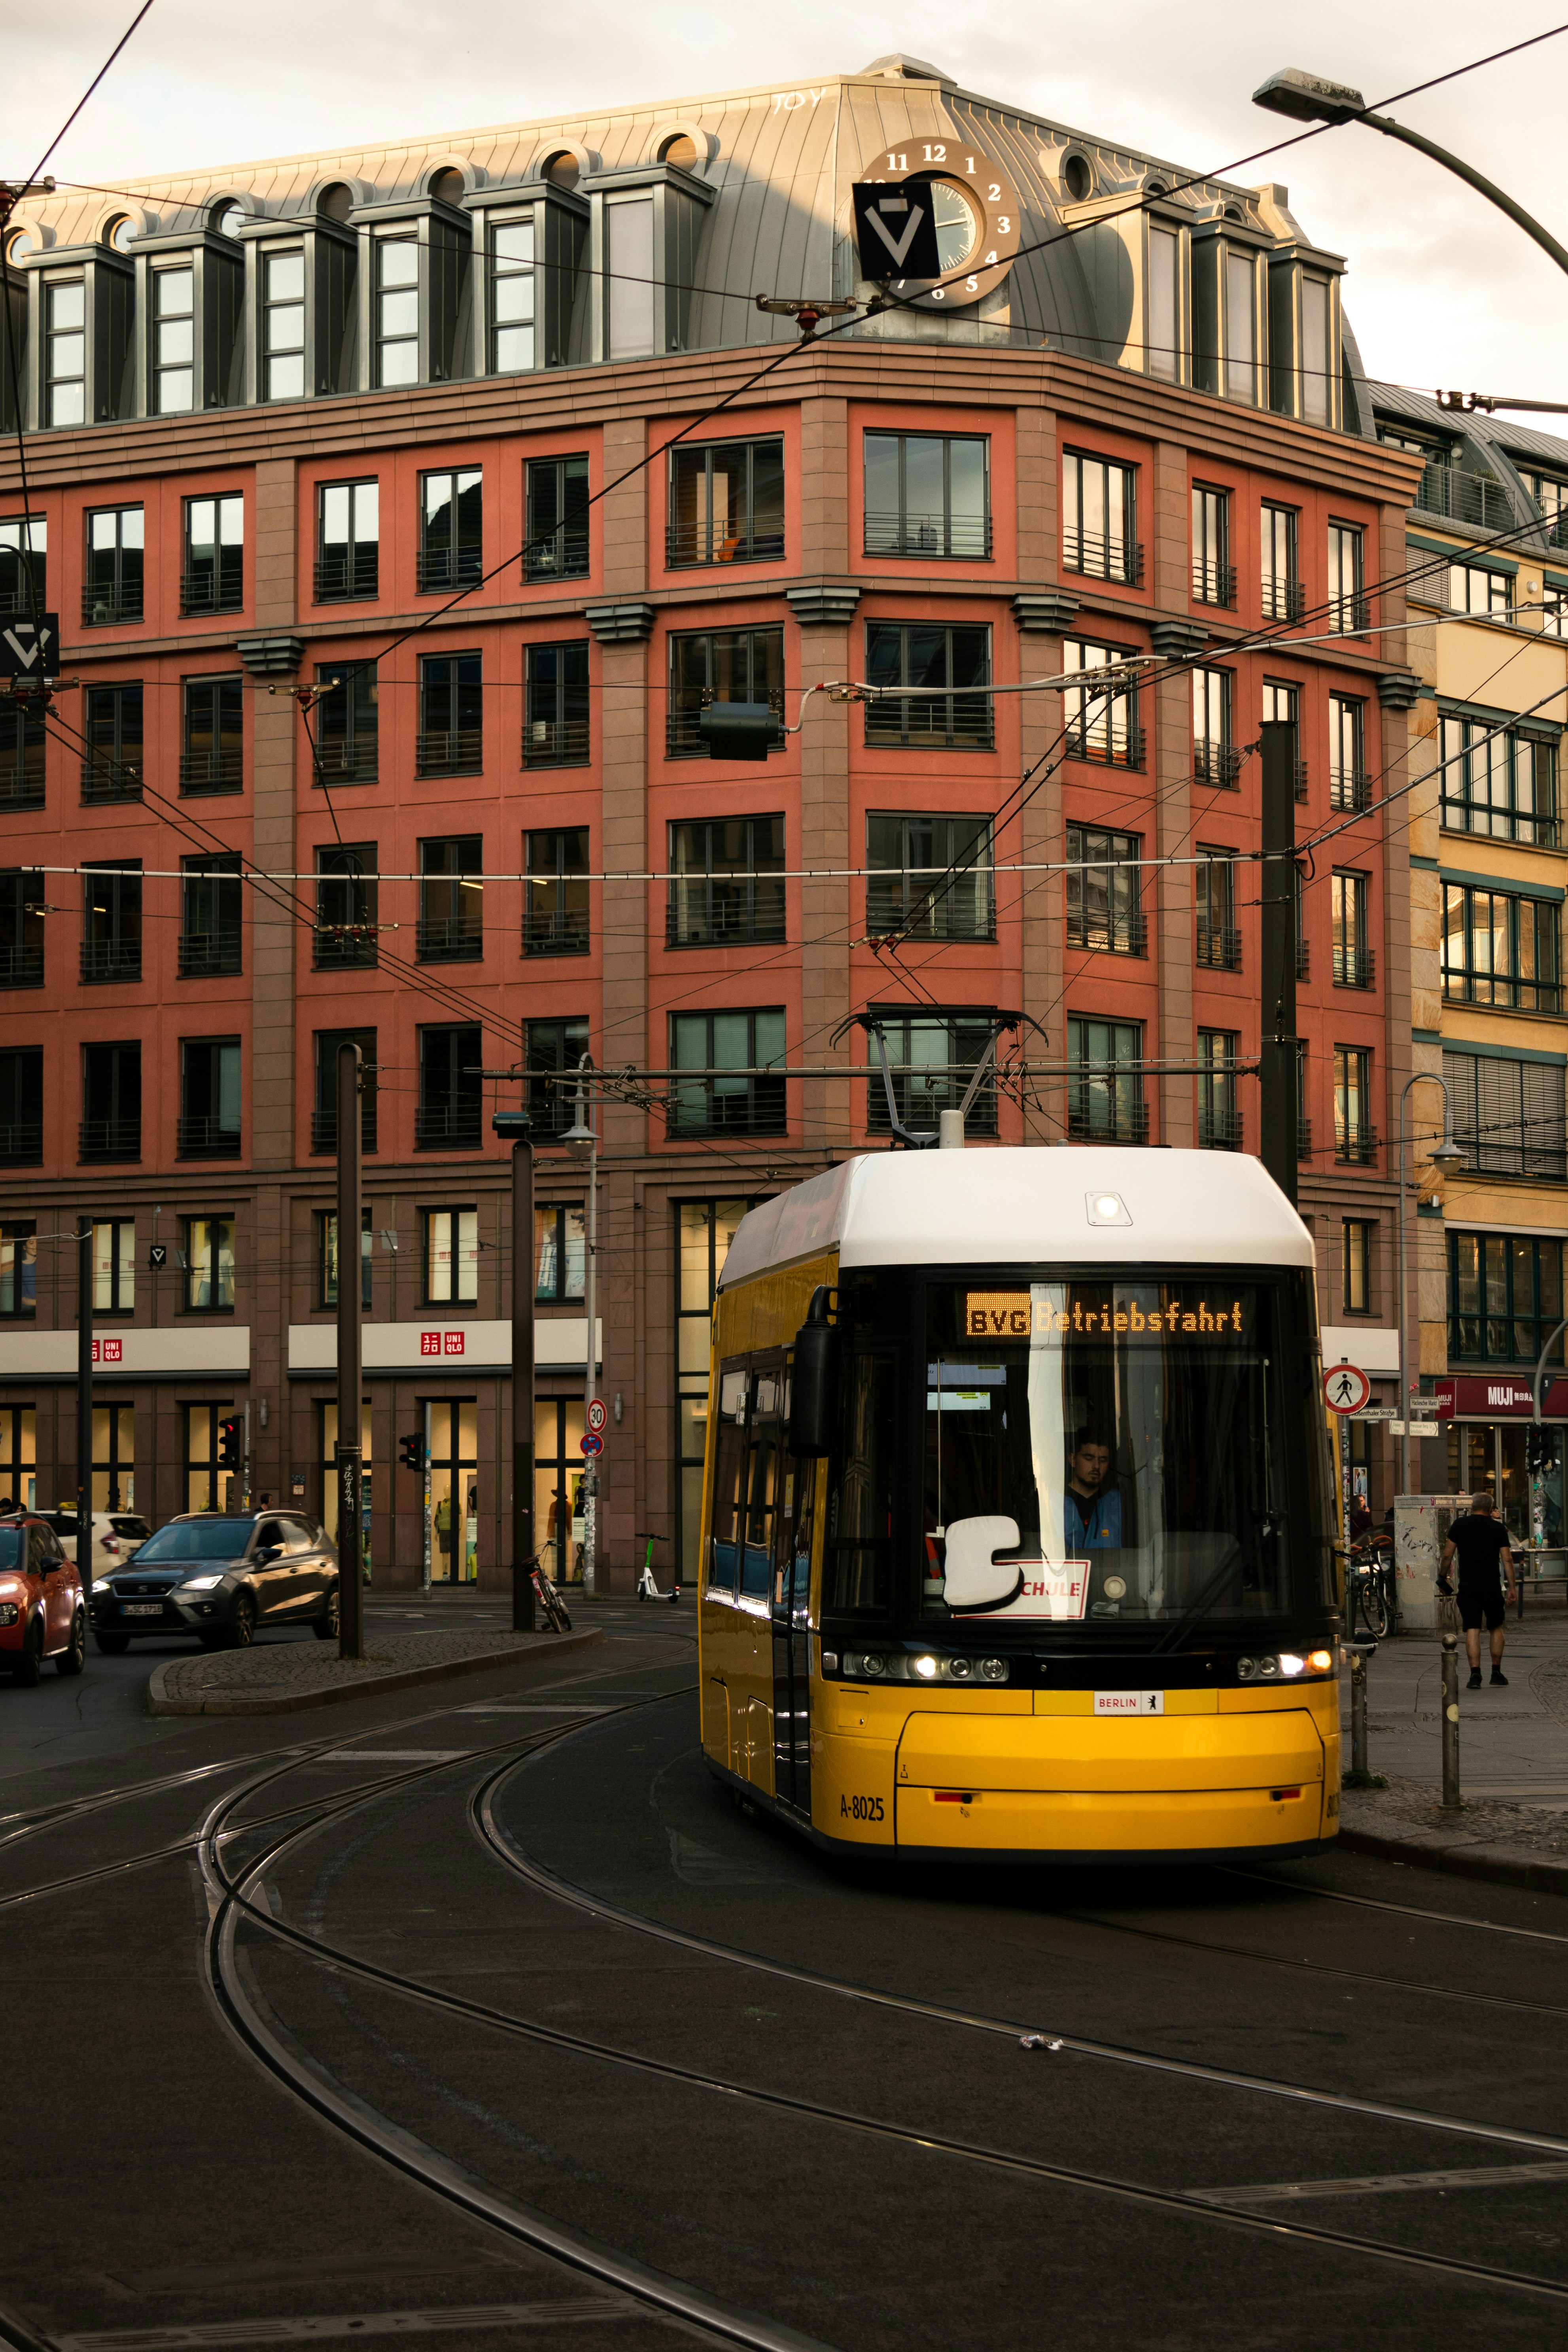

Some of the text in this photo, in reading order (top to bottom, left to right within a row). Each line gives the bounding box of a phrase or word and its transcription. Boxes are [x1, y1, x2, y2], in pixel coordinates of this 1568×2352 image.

[887, 153, 910, 171] 11
[923, 145, 947, 162] 12
[965, 157, 977, 174] 1
[988, 184, 1001, 201] 2
[997, 216, 1011, 234] 3
[985, 251, 999, 268] 4
[931, 283, 945, 300] 6
[965, 275, 978, 292] 5
[971, 1301, 1242, 1334] BVG Betriebsfahrt
[105, 1351, 120, 1360] QLO
[446, 1343, 462, 1353] QLO
[1488, 1387, 1513, 1406] MUJI
[590, 1408, 602, 1424] 30
[1099, 1697, 1137, 1709] BERLIN
[841, 1794, 885, 1822] A-8025
